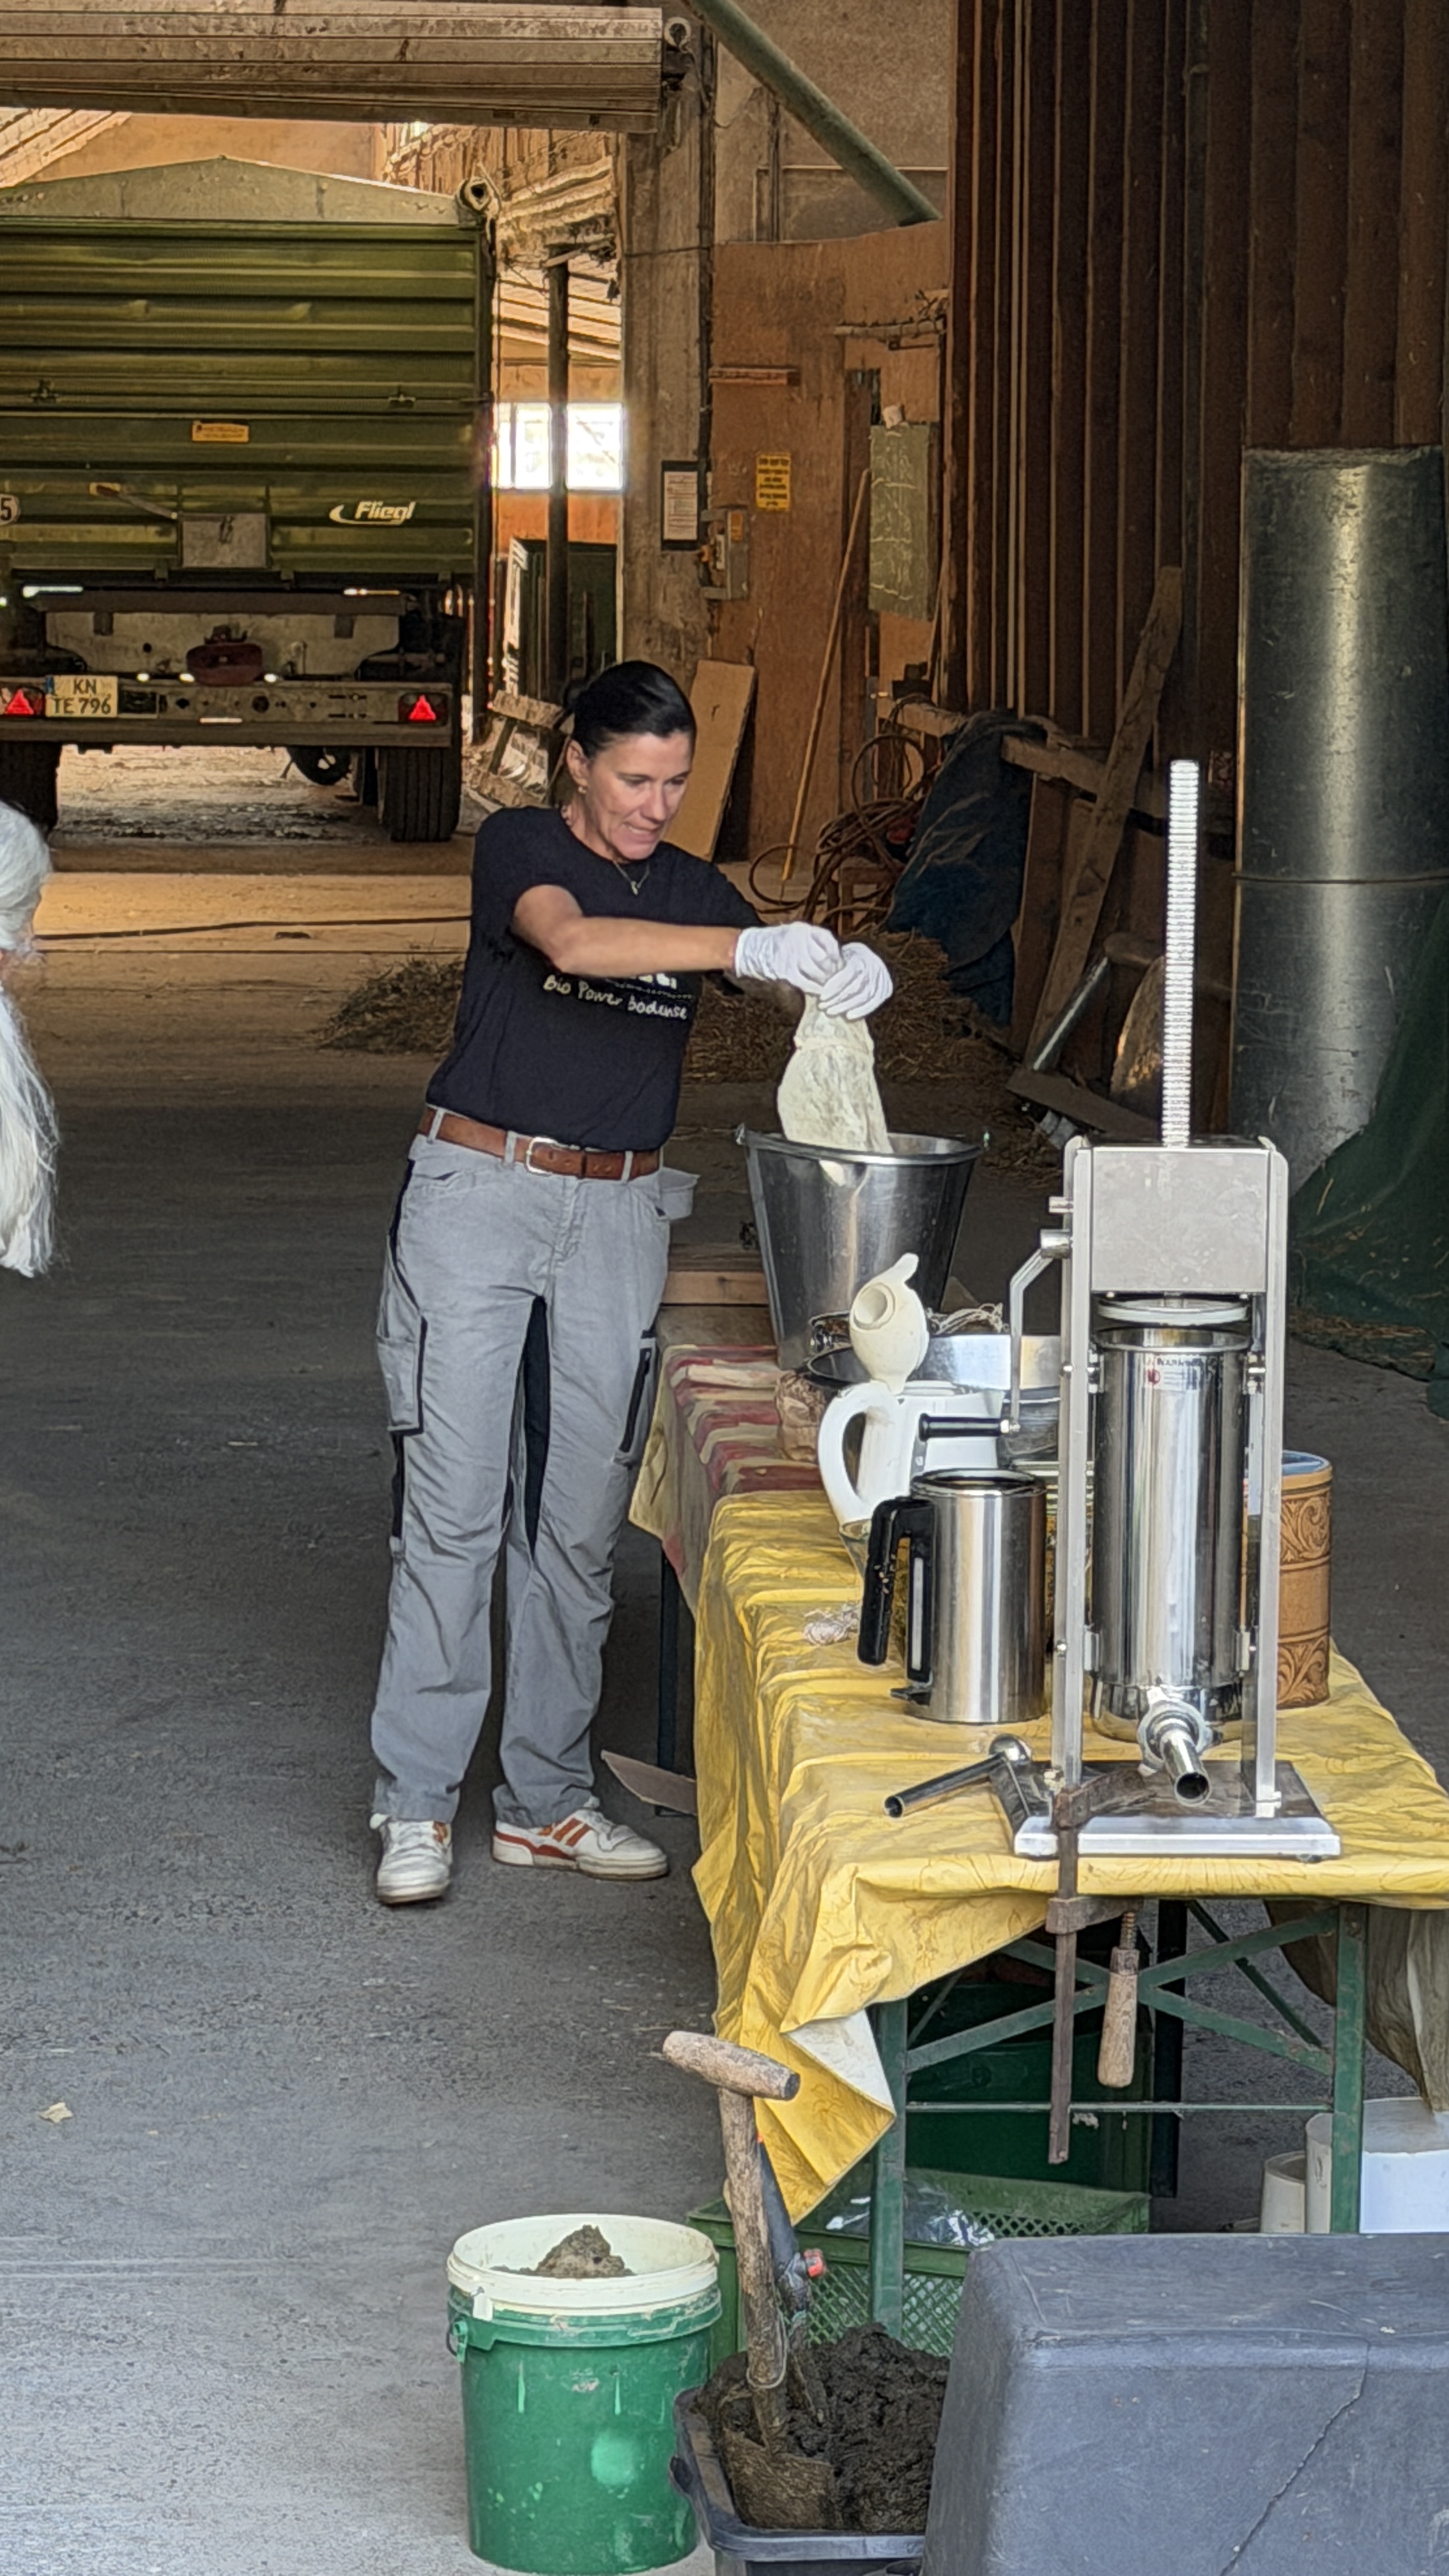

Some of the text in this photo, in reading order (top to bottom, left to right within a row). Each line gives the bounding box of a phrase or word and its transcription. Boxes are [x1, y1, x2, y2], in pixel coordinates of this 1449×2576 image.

[355, 501, 417, 525] Fliegl
[73, 678, 97, 695] KN
[54, 694, 111, 714] TE 796
[543, 974, 571, 995] Bio
[578, 981, 624, 1006] Power
